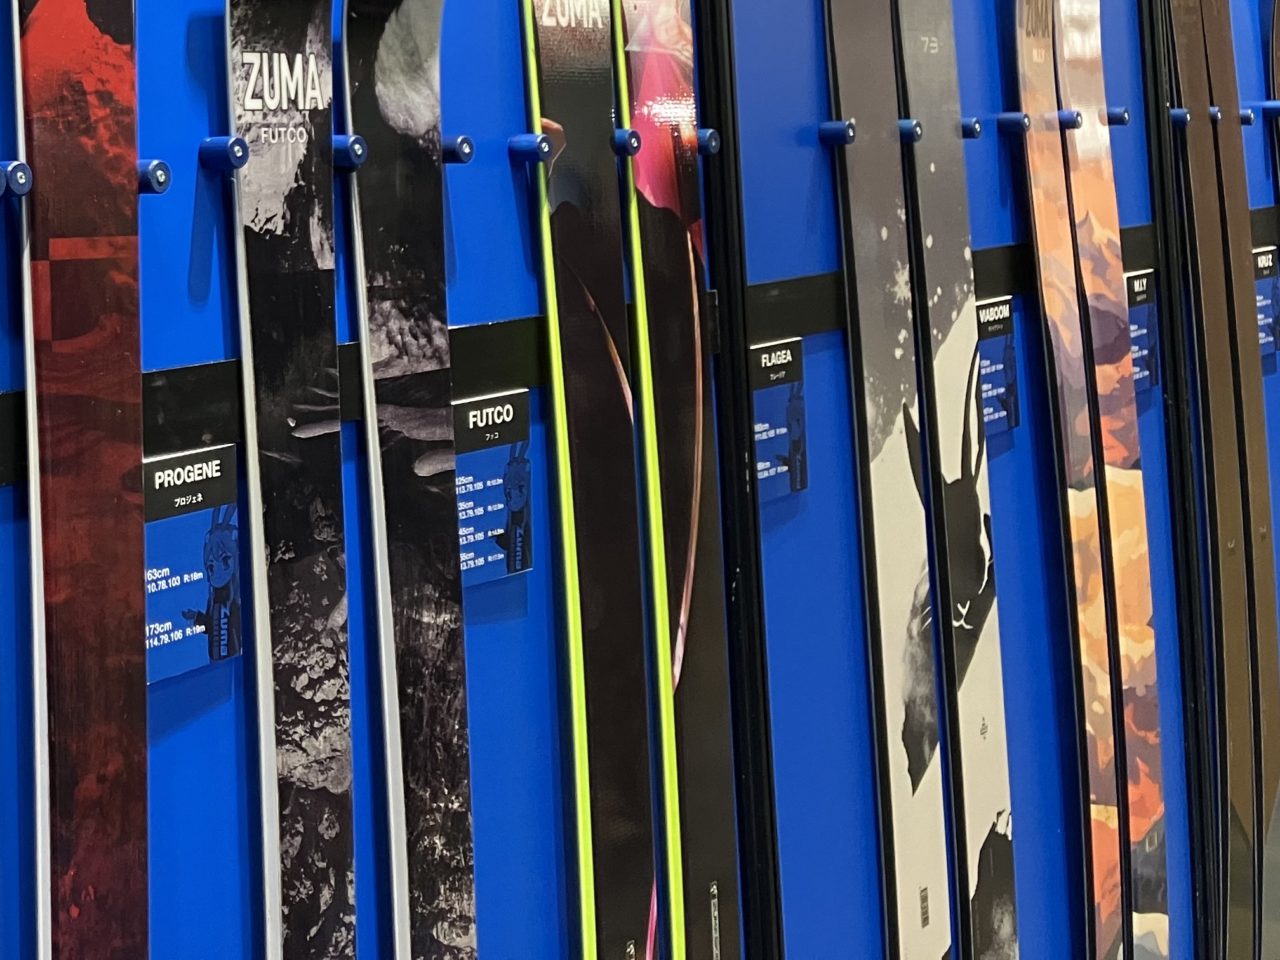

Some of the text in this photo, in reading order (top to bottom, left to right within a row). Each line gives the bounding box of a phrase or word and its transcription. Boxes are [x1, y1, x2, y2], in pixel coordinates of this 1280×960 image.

[242, 52, 324, 110] ZUMA
[261, 127, 307, 143] FUTCO
[761, 349, 792, 368] FLAGEA
[469, 403, 513, 429] FUTCO
[155, 460, 221, 489] PROGENE
[174, 493, 203, 507] プロジェネ
[147, 572, 203, 593] 10.78.103 R:18m
[146, 621, 172, 637] 173cm
[145, 630, 183, 649] 114.79.106
